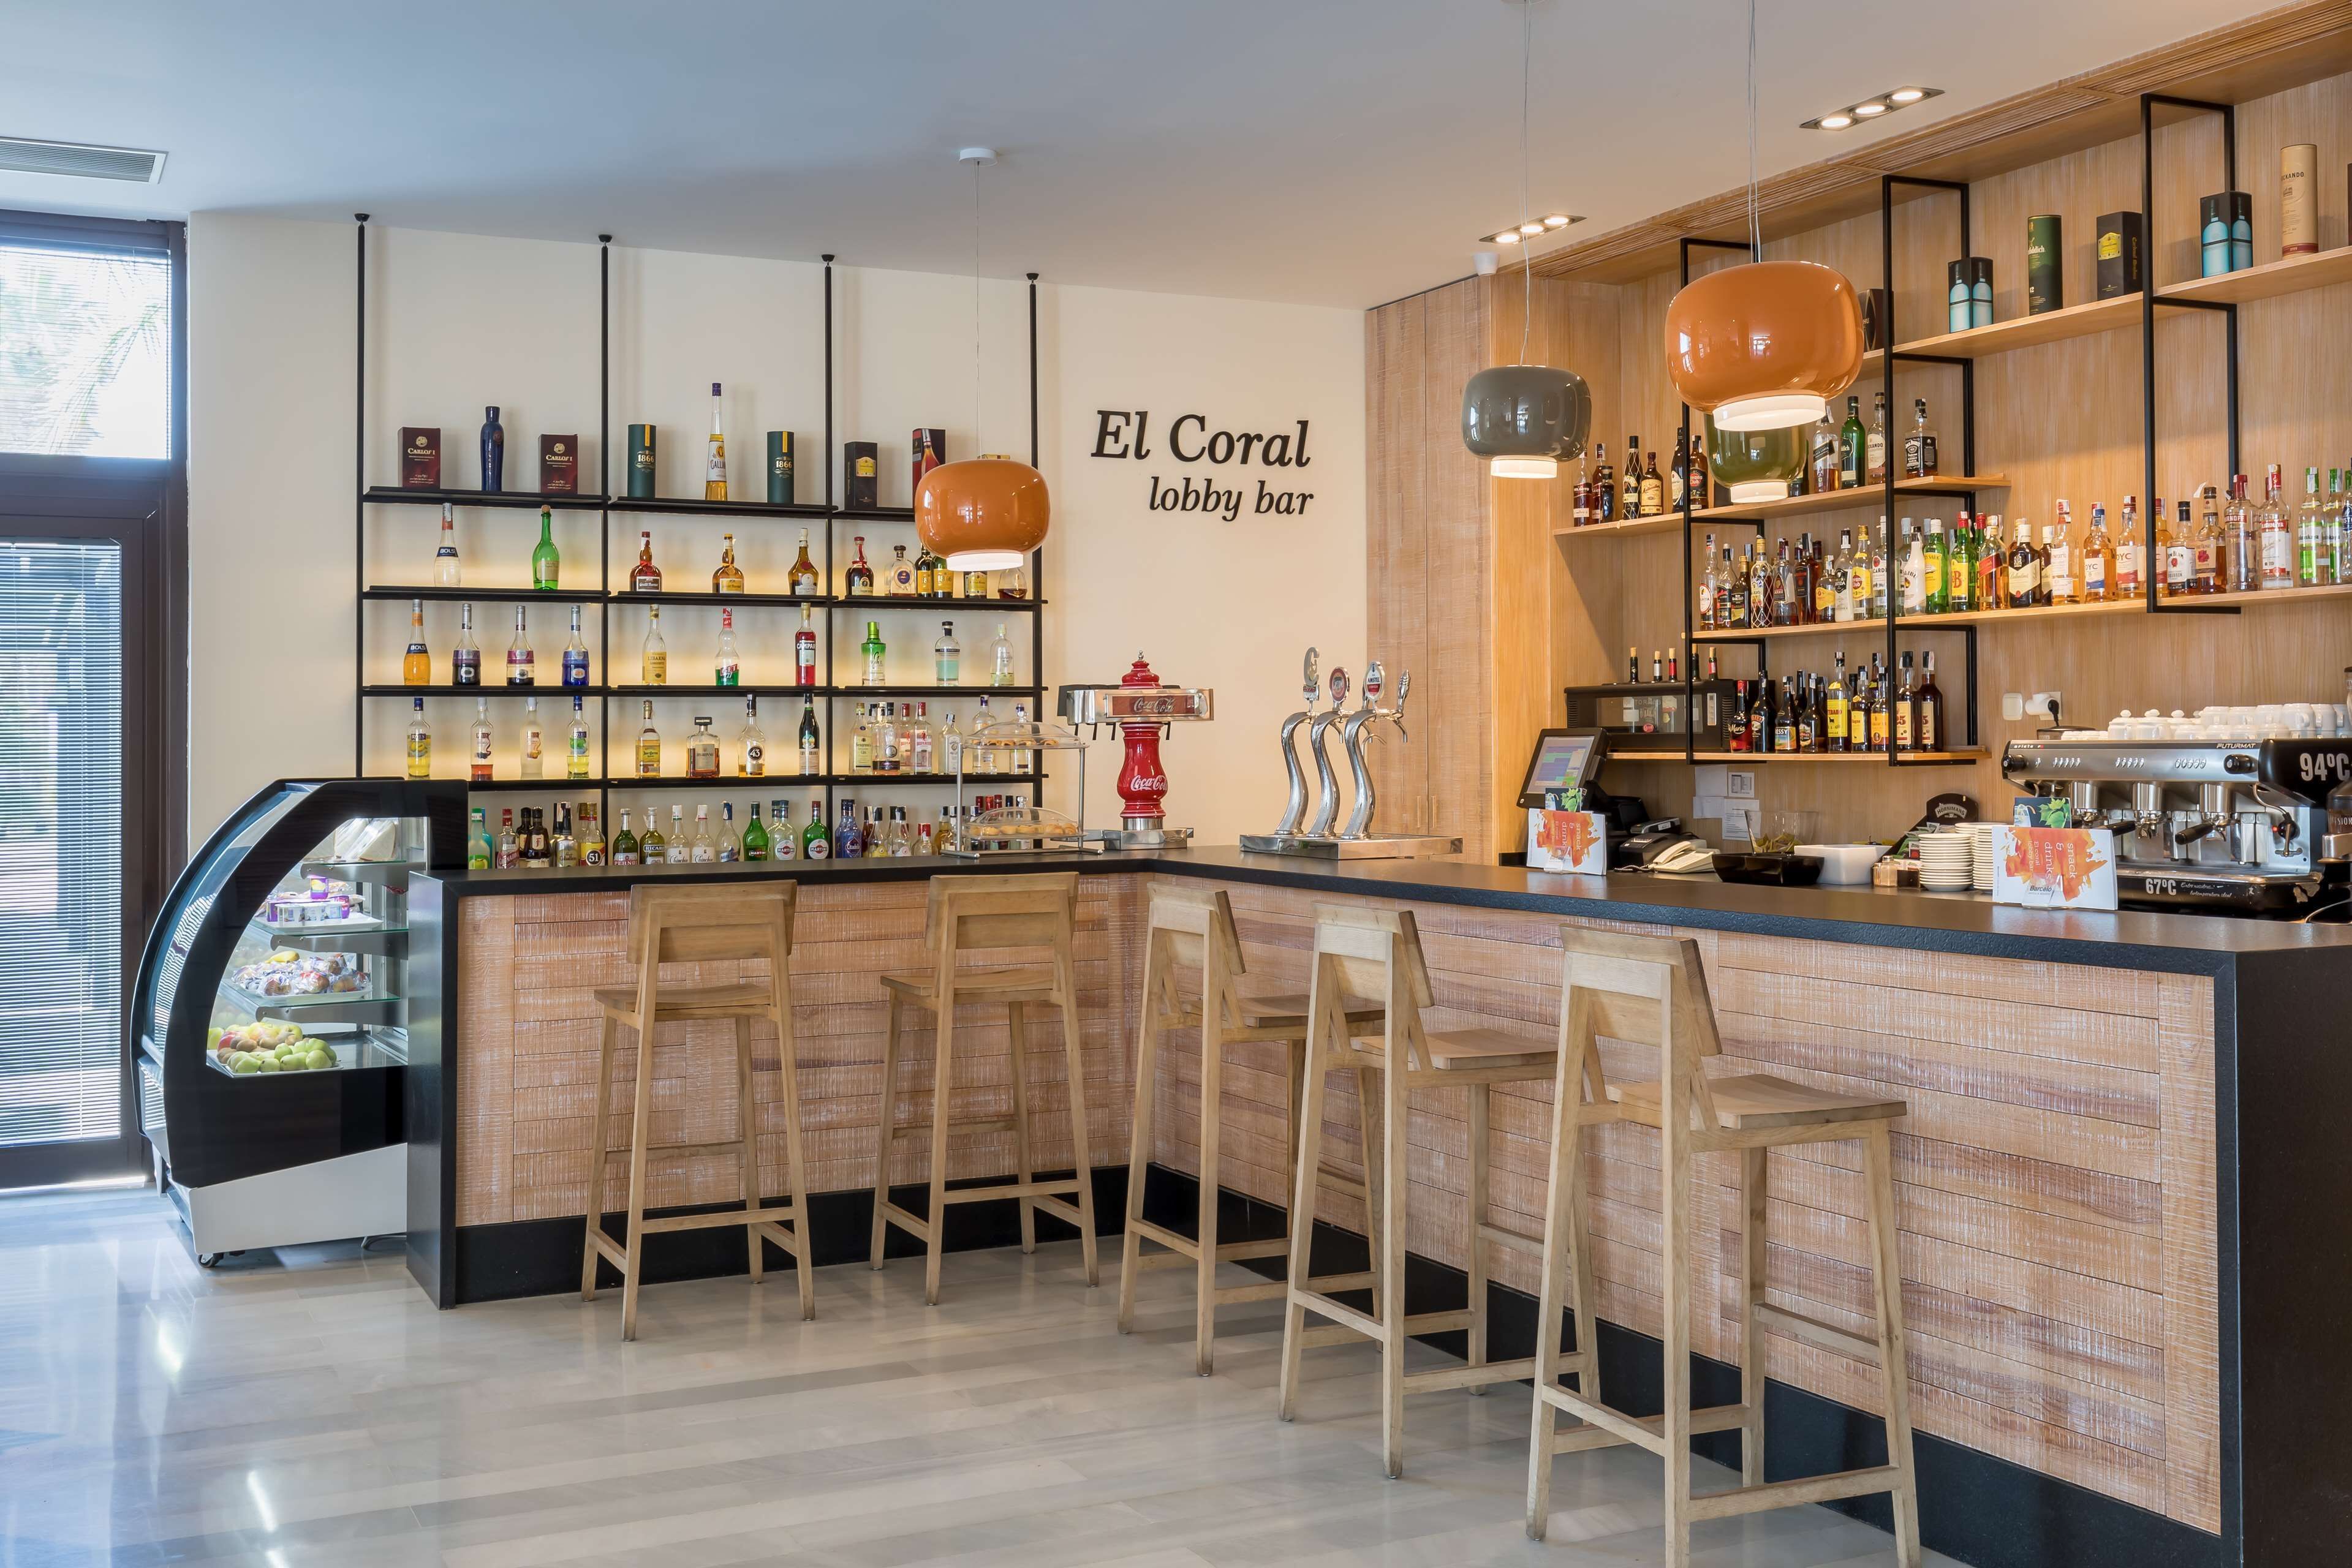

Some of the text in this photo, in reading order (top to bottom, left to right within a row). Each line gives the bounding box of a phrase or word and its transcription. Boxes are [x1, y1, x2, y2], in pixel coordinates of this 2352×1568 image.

[1091, 410, 1312, 467] El Coral
[638, 454, 655, 462] 1866
[776, 460, 793, 469] 1866
[1149, 476, 1314, 522] lobby bar
[749, 748, 760, 758] 43
[1130, 775, 1168, 791] Coca-Col
[1937, 806, 1965, 816] HORNIMANS
[2055, 842, 2064, 851] &
[588, 853, 599, 862] 51
[2044, 842, 2054, 880] drinks
[2067, 842, 2078, 879] snack
